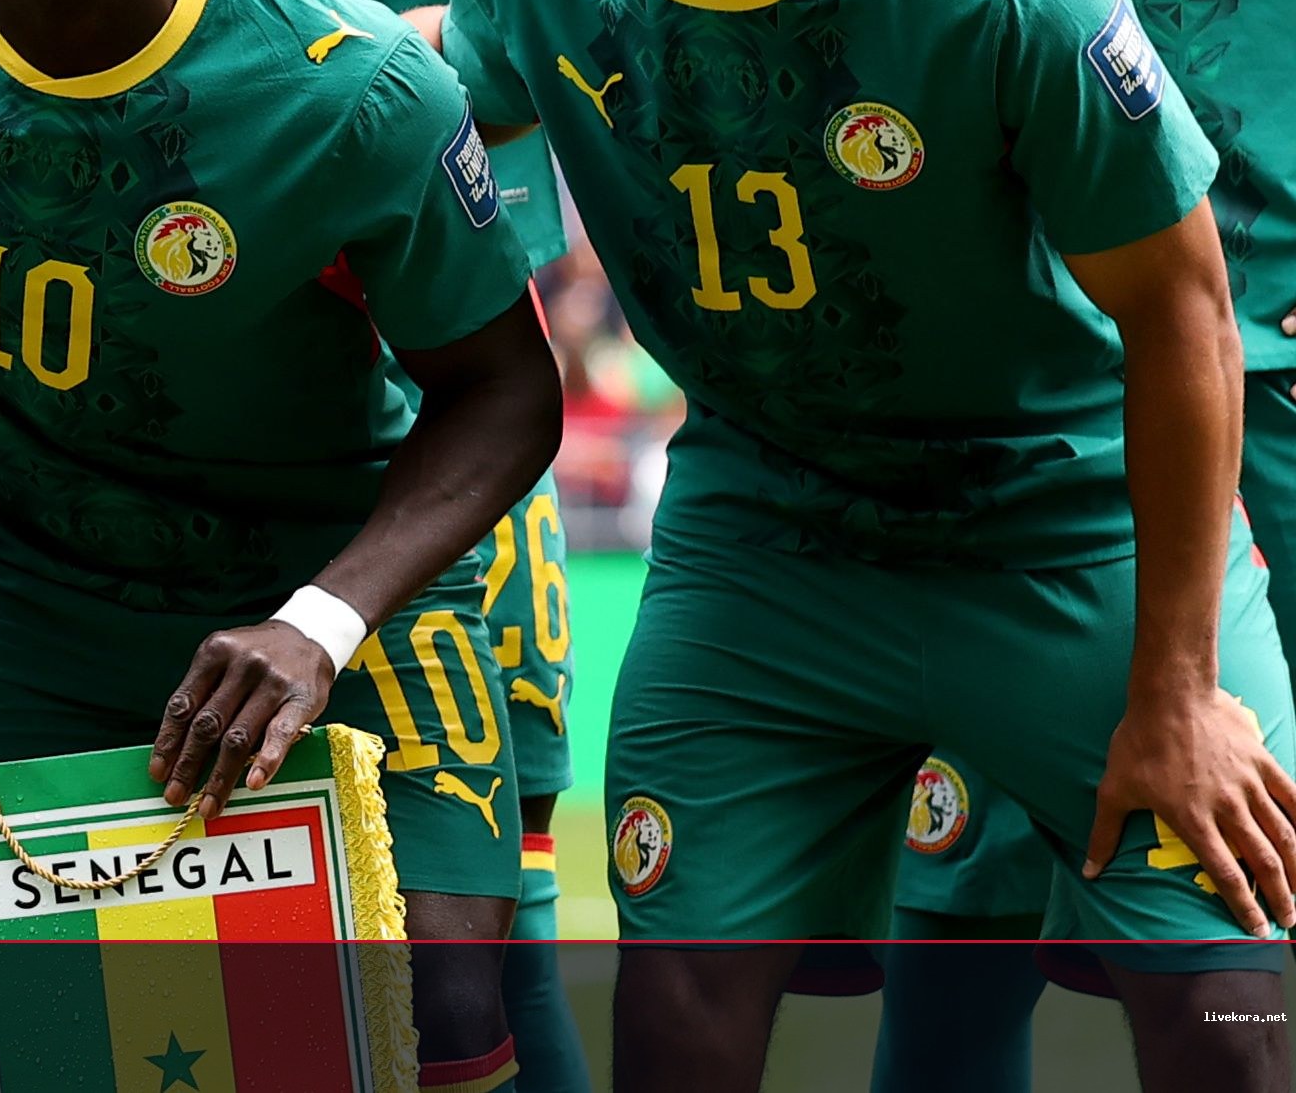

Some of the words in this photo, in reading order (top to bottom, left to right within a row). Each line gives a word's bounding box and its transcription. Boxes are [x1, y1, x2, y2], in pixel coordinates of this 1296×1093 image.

[669, 163, 817, 311] 13
[346, 609, 501, 771] 10
[11, 838, 292, 910] SENEGAL
